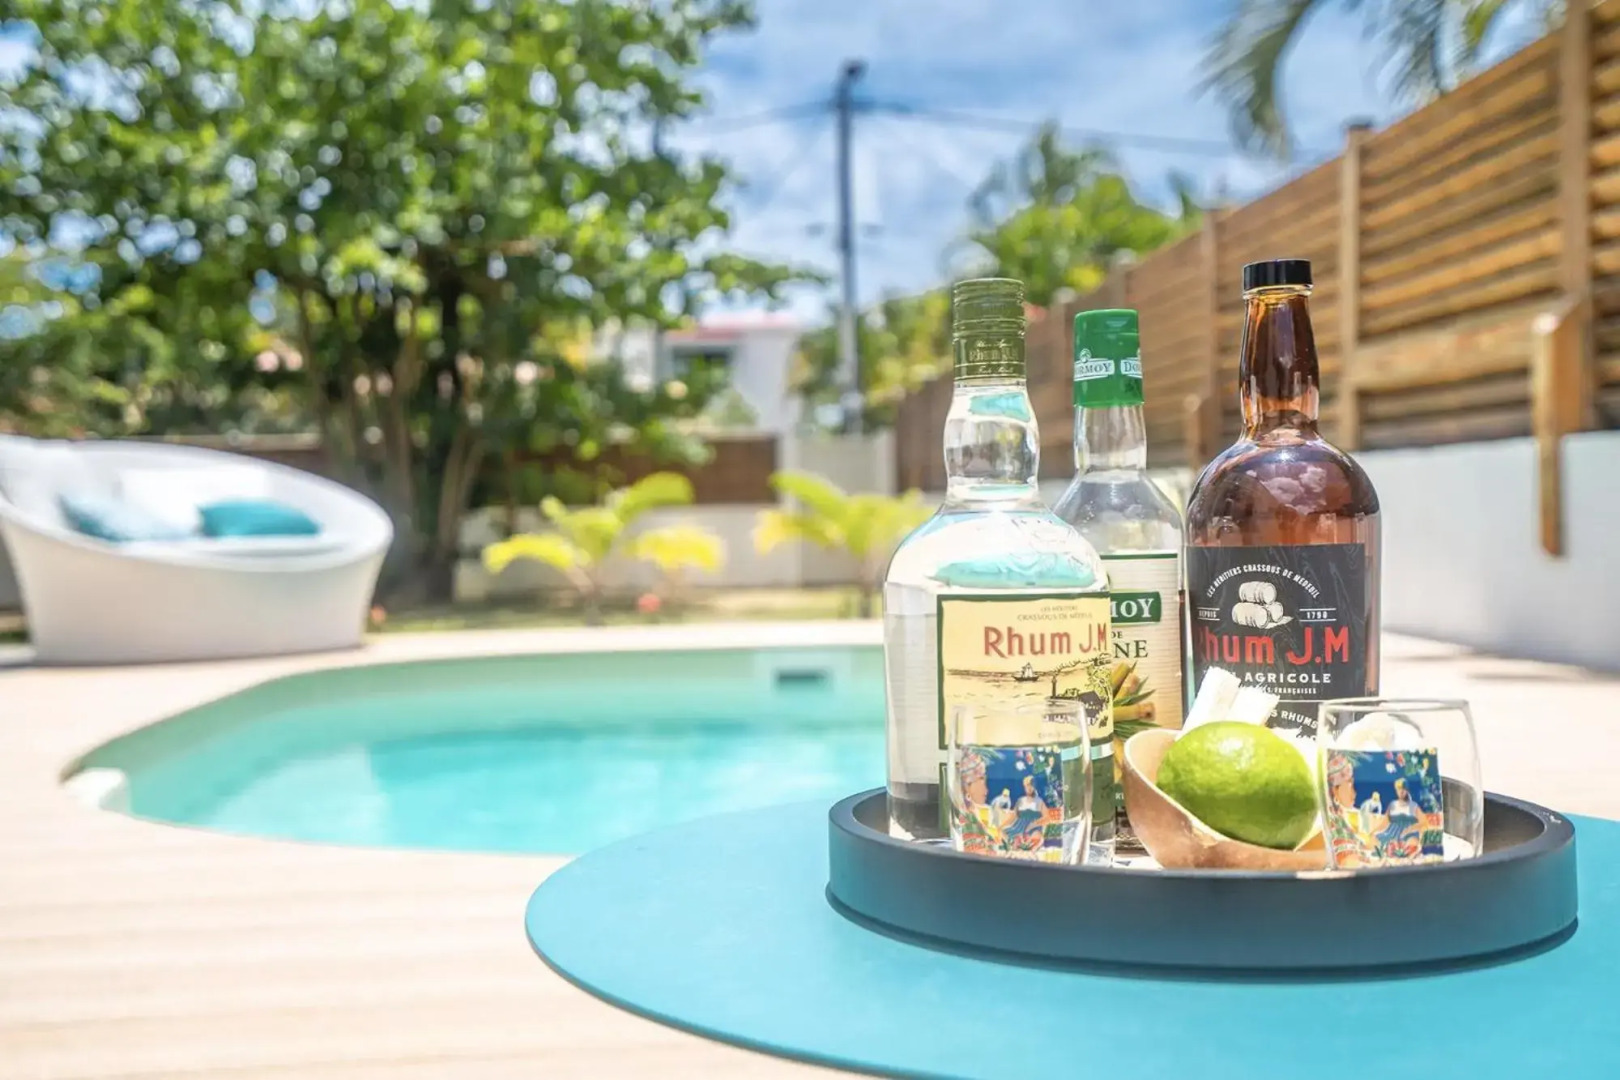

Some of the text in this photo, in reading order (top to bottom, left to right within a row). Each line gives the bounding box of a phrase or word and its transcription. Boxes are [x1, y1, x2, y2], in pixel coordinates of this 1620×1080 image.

[1124, 361, 1141, 372] DO
[1282, 569, 1293, 579] DE
[984, 623, 1107, 659] Rhum J.M
[1286, 626, 1349, 665] J.M
[1244, 673, 1332, 683] AGRICOLE
[1281, 710, 1318, 729] RHUMS
